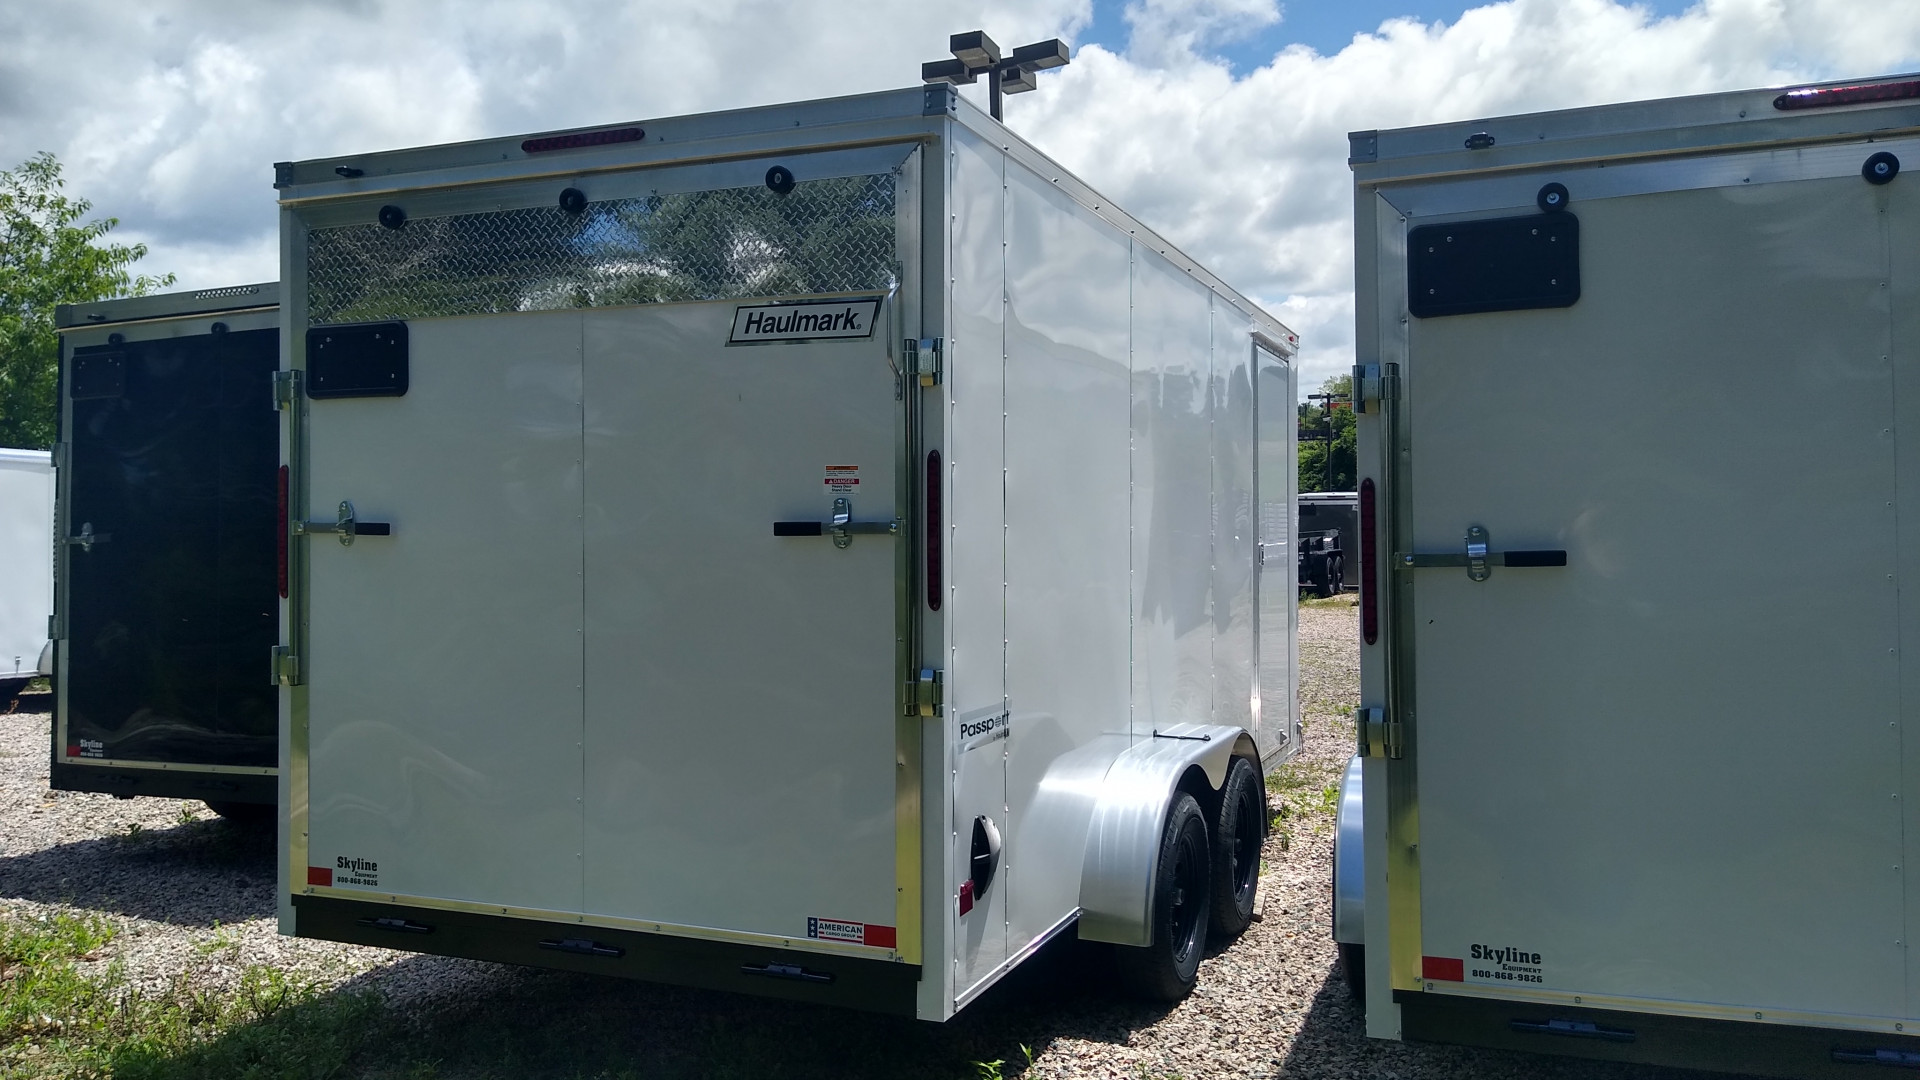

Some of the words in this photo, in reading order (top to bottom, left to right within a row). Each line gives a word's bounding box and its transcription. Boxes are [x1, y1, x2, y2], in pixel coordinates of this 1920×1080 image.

[744, 307, 860, 334] Haulmark
[960, 710, 1009, 740] Passport
[80, 739, 103, 749] Skyline
[337, 856, 378, 872] Skyline
[337, 876, 378, 886] 800-868-9826
[819, 923, 862, 934] AMERICAN
[1470, 944, 1542, 965] Skyline
[1472, 969, 1543, 983] 800-868-9826
